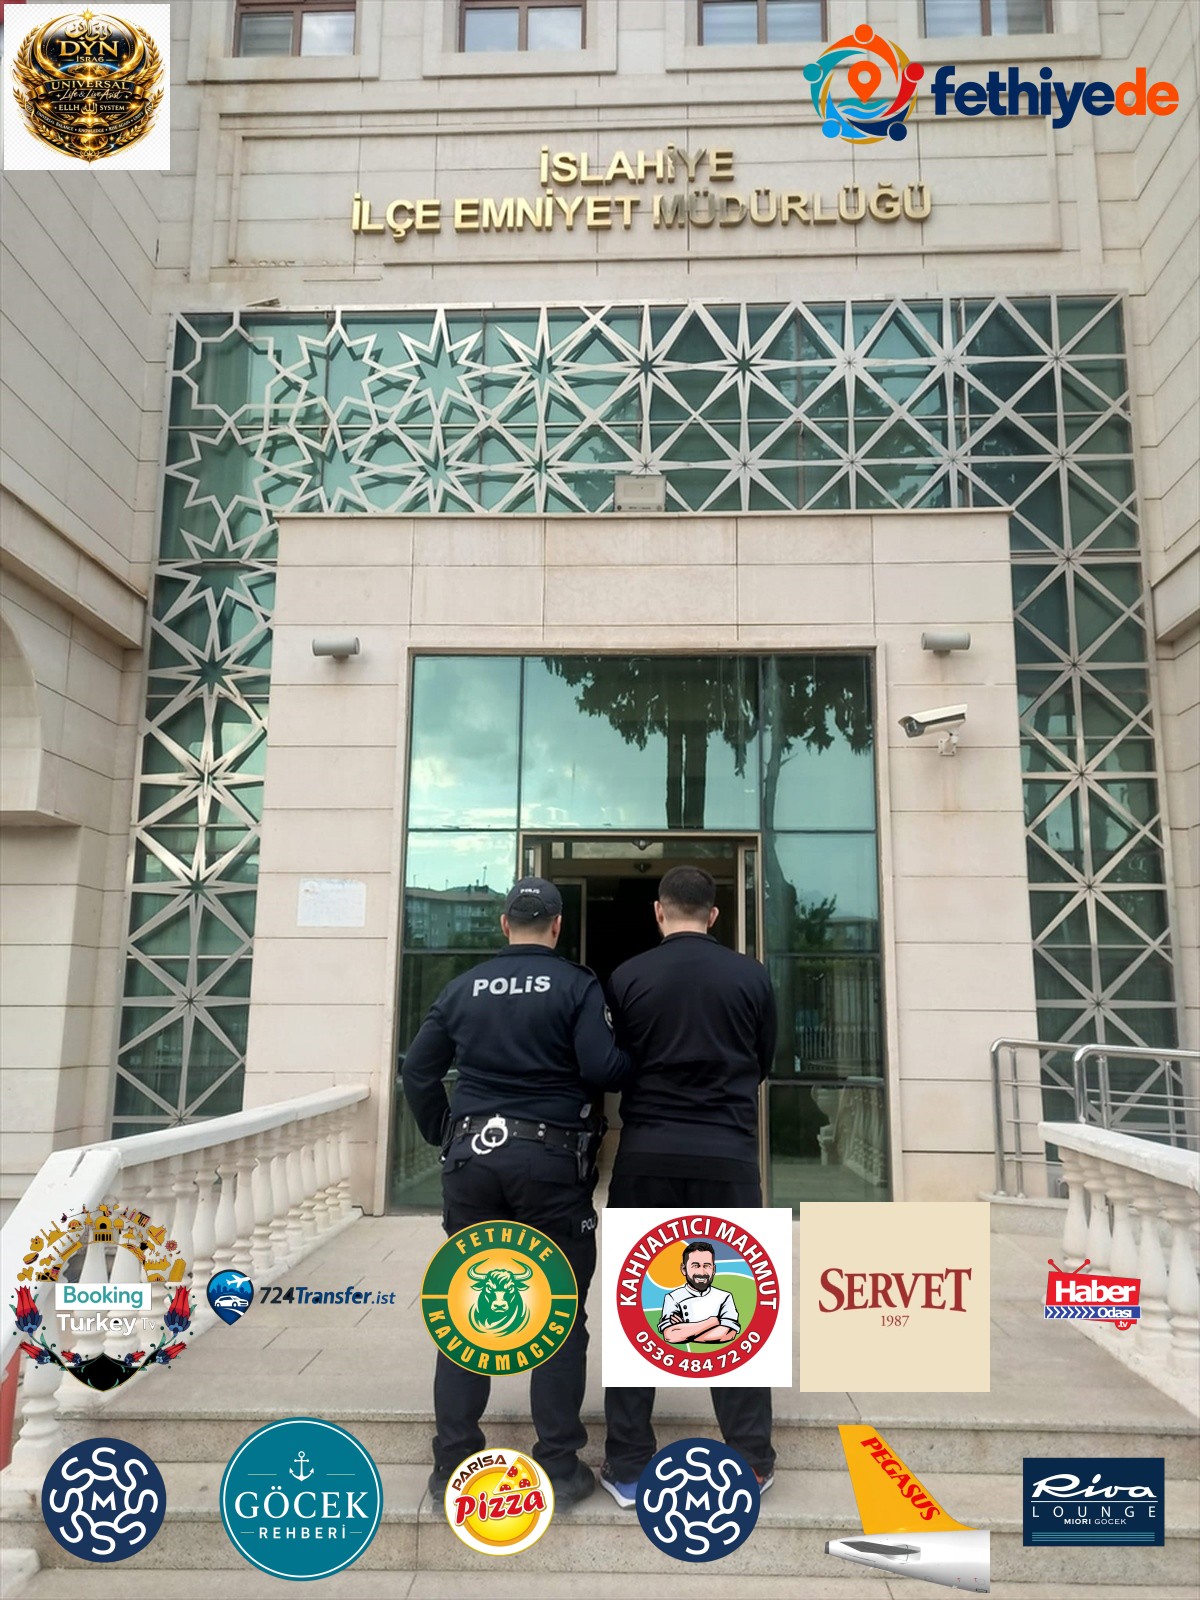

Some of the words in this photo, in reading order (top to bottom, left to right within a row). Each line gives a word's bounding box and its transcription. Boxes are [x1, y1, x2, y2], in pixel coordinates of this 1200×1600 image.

[540, 142, 735, 187] İSLAHİYE
[351, 192, 441, 242] İLÇE
[454, 187, 640, 234] EMNİYET
[652, 181, 934, 231] MÜDÜRLÜĞÜ
